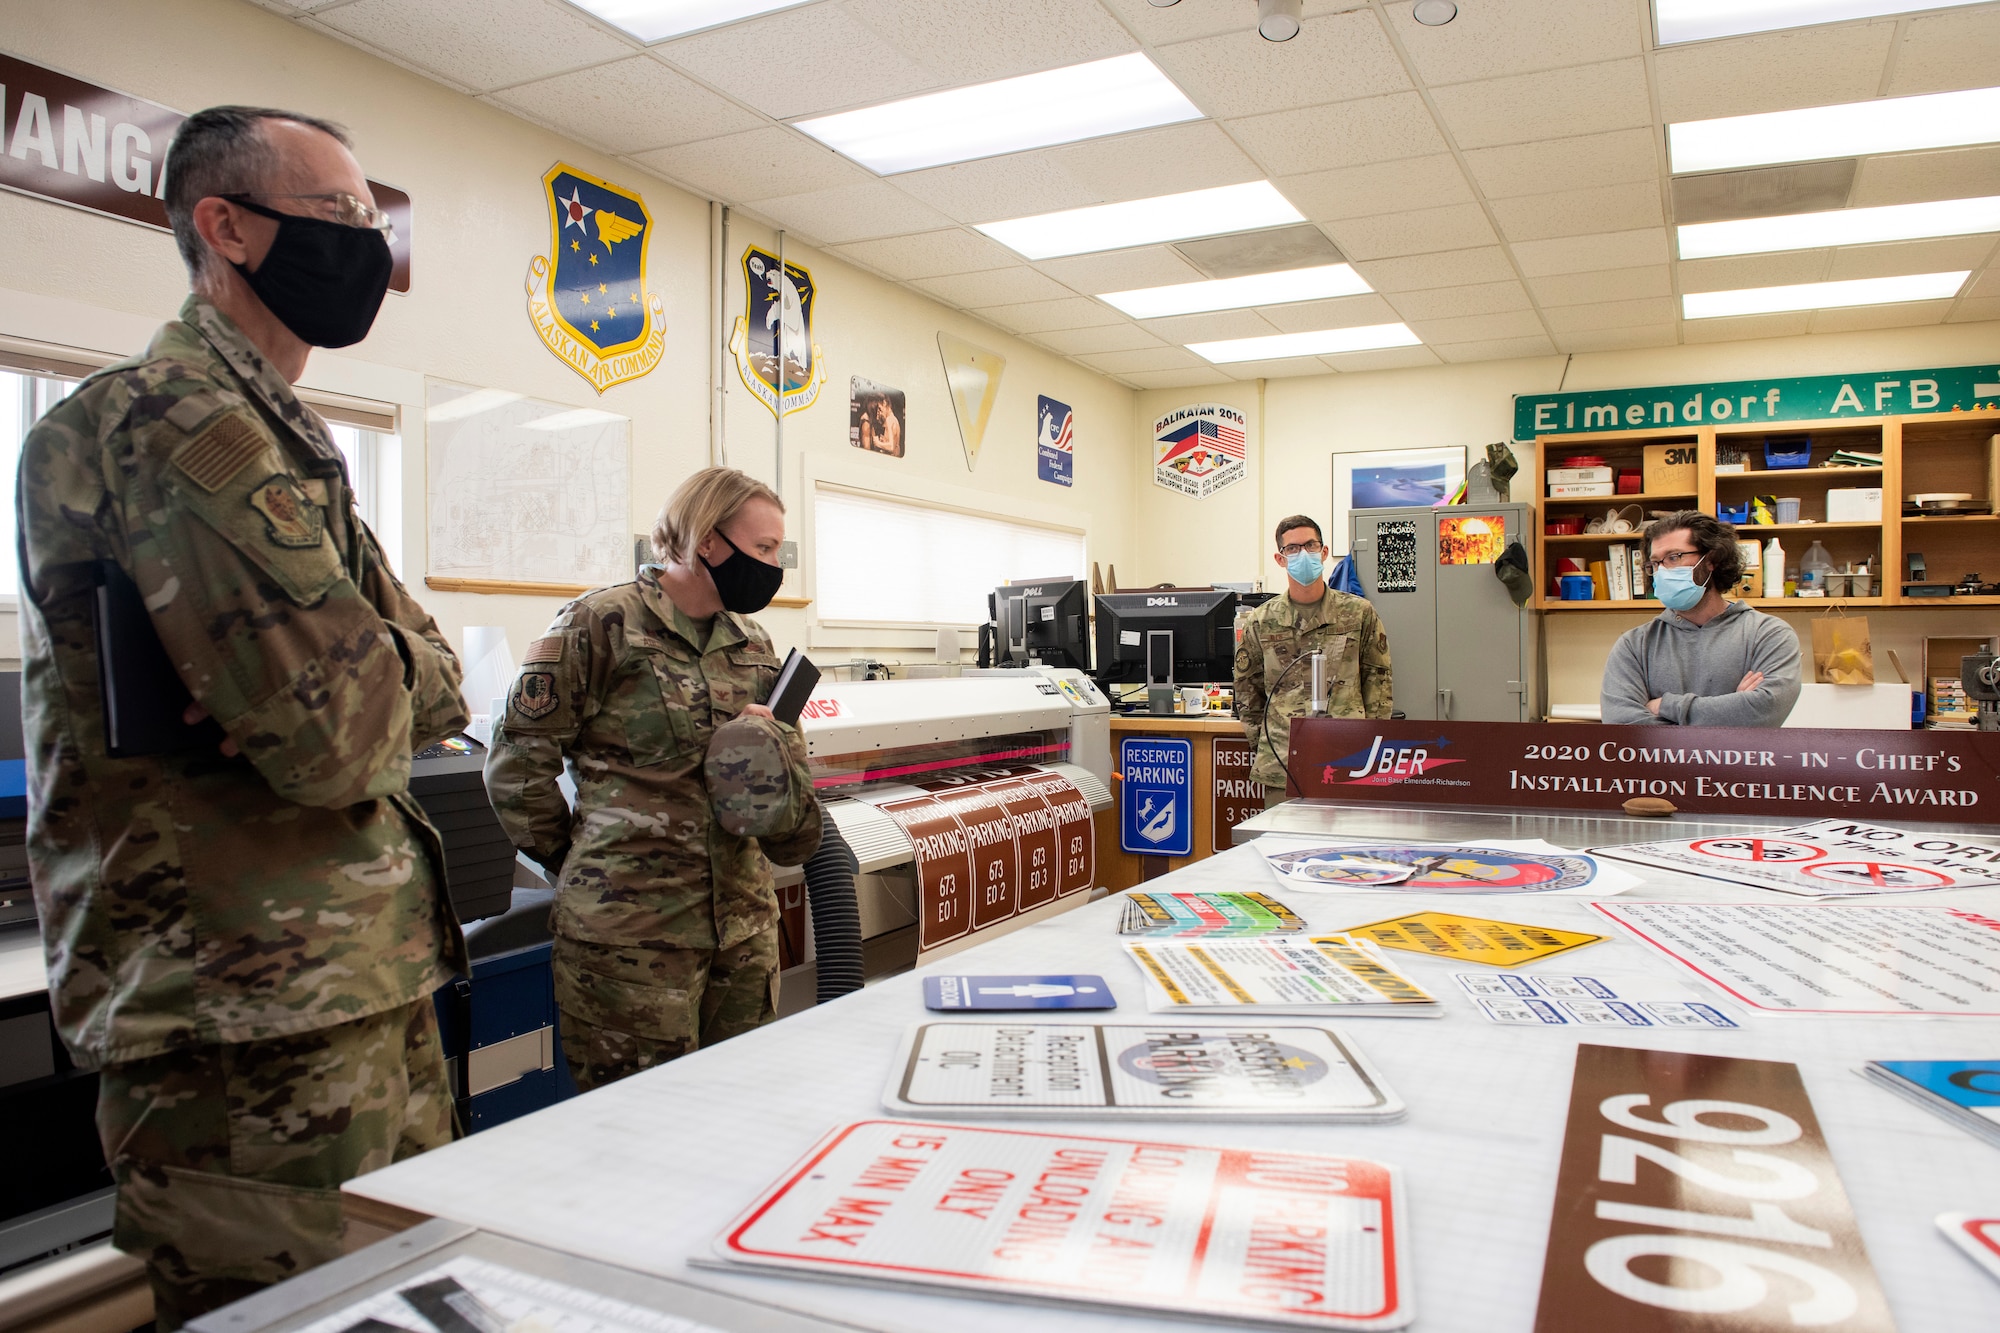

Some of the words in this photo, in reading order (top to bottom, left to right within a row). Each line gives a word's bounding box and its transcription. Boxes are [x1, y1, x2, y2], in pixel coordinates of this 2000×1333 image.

[0, 83, 177, 200] ANG
[532, 301, 589, 369] ALASKAN
[589, 361, 614, 385] AIR
[612, 330, 663, 378] COMMAND
[743, 364, 779, 411] ALASKAN
[782, 382, 817, 410] OMMAND
[1534, 388, 1781, 431] Elmendorf
[1830, 379, 1941, 414] AFB
[1156, 407, 1215, 433] BALIKATAN
[1219, 408, 1244, 425] 2016
[1665, 449, 1697, 465] 3M
[1157, 476, 1183, 491] PHILIPPINE
[1184, 486, 1199, 496] ARMY
[1378, 526, 1389, 536] ALL
[1392, 526, 1416, 535] ROADS
[1022, 587, 1043, 597] DELL
[1378, 580, 1416, 588] CONVERGE
[1147, 597, 1178, 607] DELL
[801, 699, 841, 719] NASA
[1127, 749, 1184, 764] RESERVED
[1349, 735, 1428, 778] JBER
[1524, 744, 1590, 762] 2020
[1036, 776, 1075, 795] RESERVED
[1127, 766, 1184, 785] PARKING
[1372, 776, 1387, 784] Joint
[1404, 777, 1471, 786] Elmendorf-Richardson
[949, 793, 996, 815] RESERVED
[993, 784, 1038, 805] RESERVED
[893, 802, 949, 827] RESERVED
[1014, 809, 1053, 837] PARKING
[1054, 799, 1090, 827] PARKING
[1226, 807, 1235, 822] 3
[967, 817, 1012, 849] PARKING
[1783, 831, 1820, 841] In
[1832, 839, 1906, 857] This
[1829, 825, 1904, 841] NO
[915, 829, 966, 863] PARKING
[1032, 847, 1046, 867] 673
[1071, 836, 1083, 855] 673
[989, 859, 1004, 881] 673
[1079, 856, 1085, 872] 4
[939, 873, 956, 898] 673
[1041, 869, 1047, 886] 3
[999, 882, 1006, 901] 2
[953, 898, 957, 917] 1
[1316, 940, 1436, 1003] CAUTION
[939, 1051, 982, 1069] OIC
[990, 1029, 1035, 1097] Detachment
[1037, 1035, 1088, 1091] Reception
[1145, 1032, 1218, 1099] PARKING
[892, 1133, 947, 1151] 15
[851, 1155, 928, 1191] MIN
[1246, 1151, 1350, 1191] NO
[934, 1168, 1015, 1220] ONLY
[1103, 1146, 1188, 1228] LOADING
[993, 1148, 1108, 1262] UNLOADING
[1584, 1093, 1859, 1327] 9216
[799, 1197, 892, 1247] MAX
[1239, 1194, 1329, 1307] PARKING
